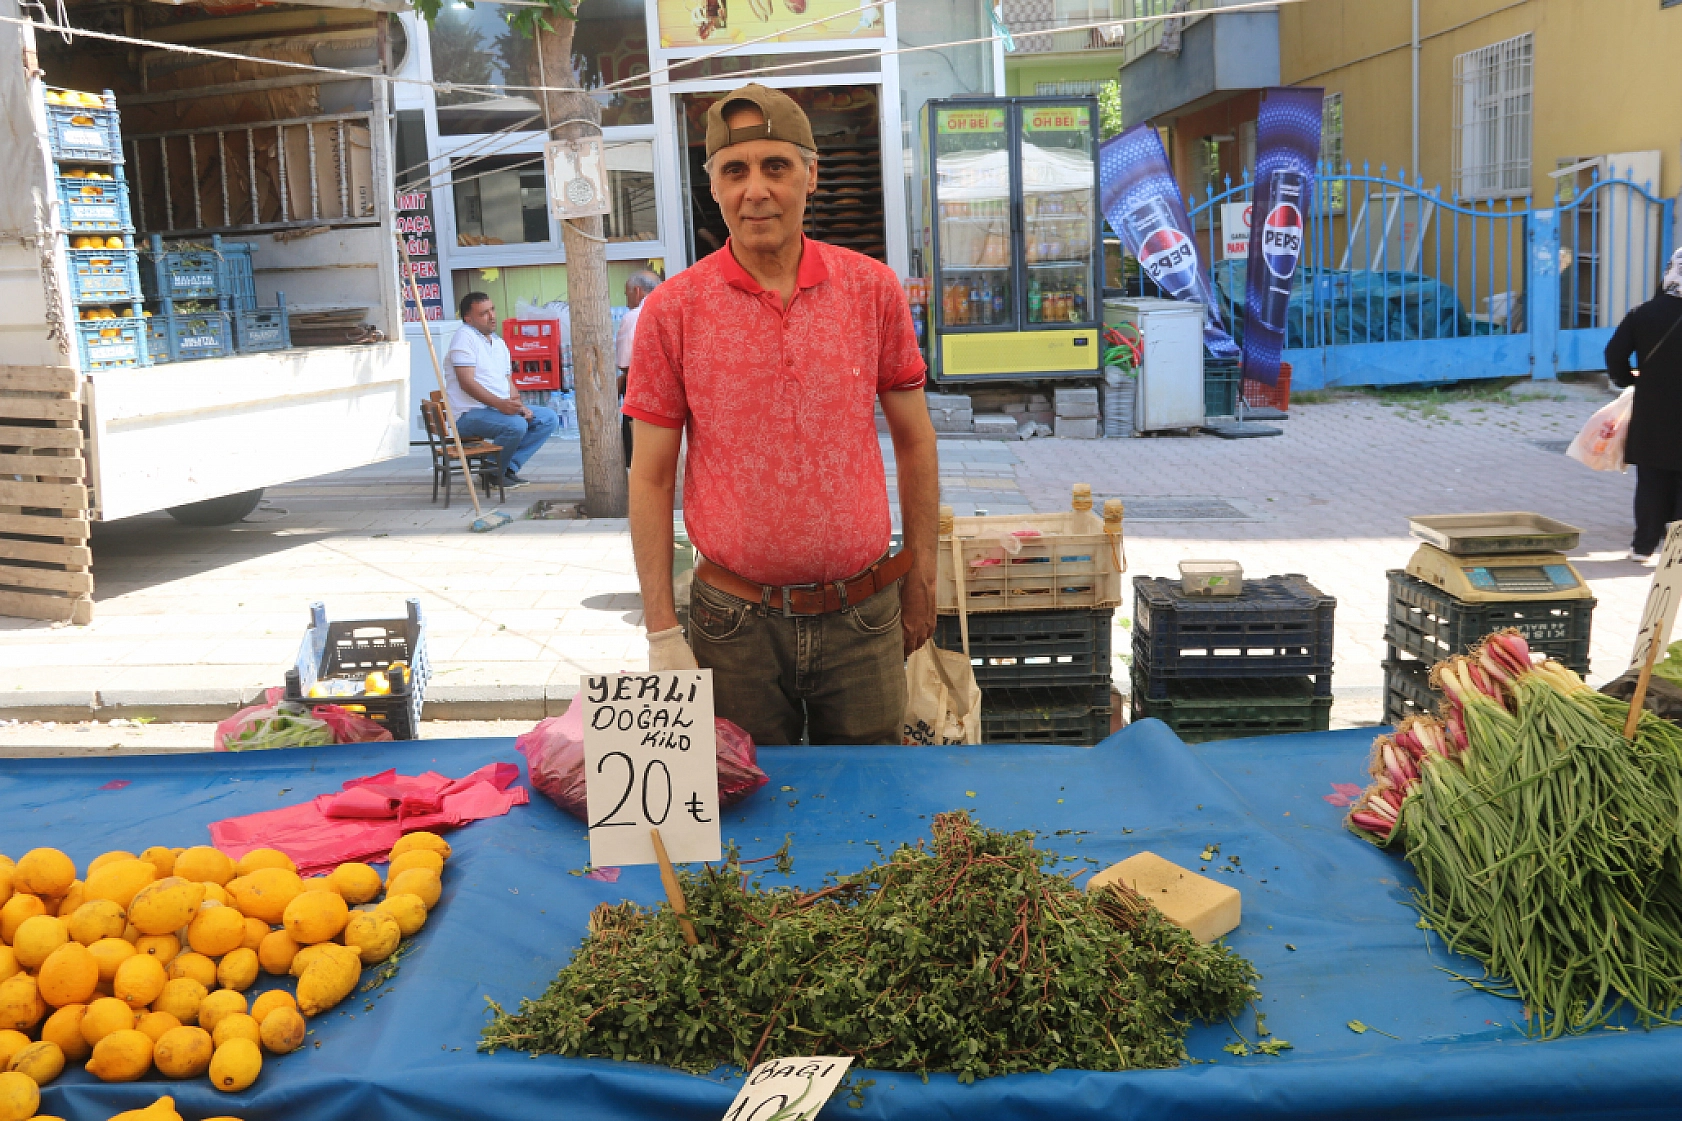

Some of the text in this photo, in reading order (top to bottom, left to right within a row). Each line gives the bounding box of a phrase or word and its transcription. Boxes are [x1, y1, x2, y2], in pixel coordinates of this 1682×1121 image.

[948, 118, 967, 130] OH
[1033, 117, 1052, 128] OH
[397, 189, 427, 209] İMİT
[1264, 229, 1299, 251] PEPS
[587, 674, 702, 704] YERLİ
[591, 703, 694, 731] DOĞAL
[588, 751, 673, 831] 20
